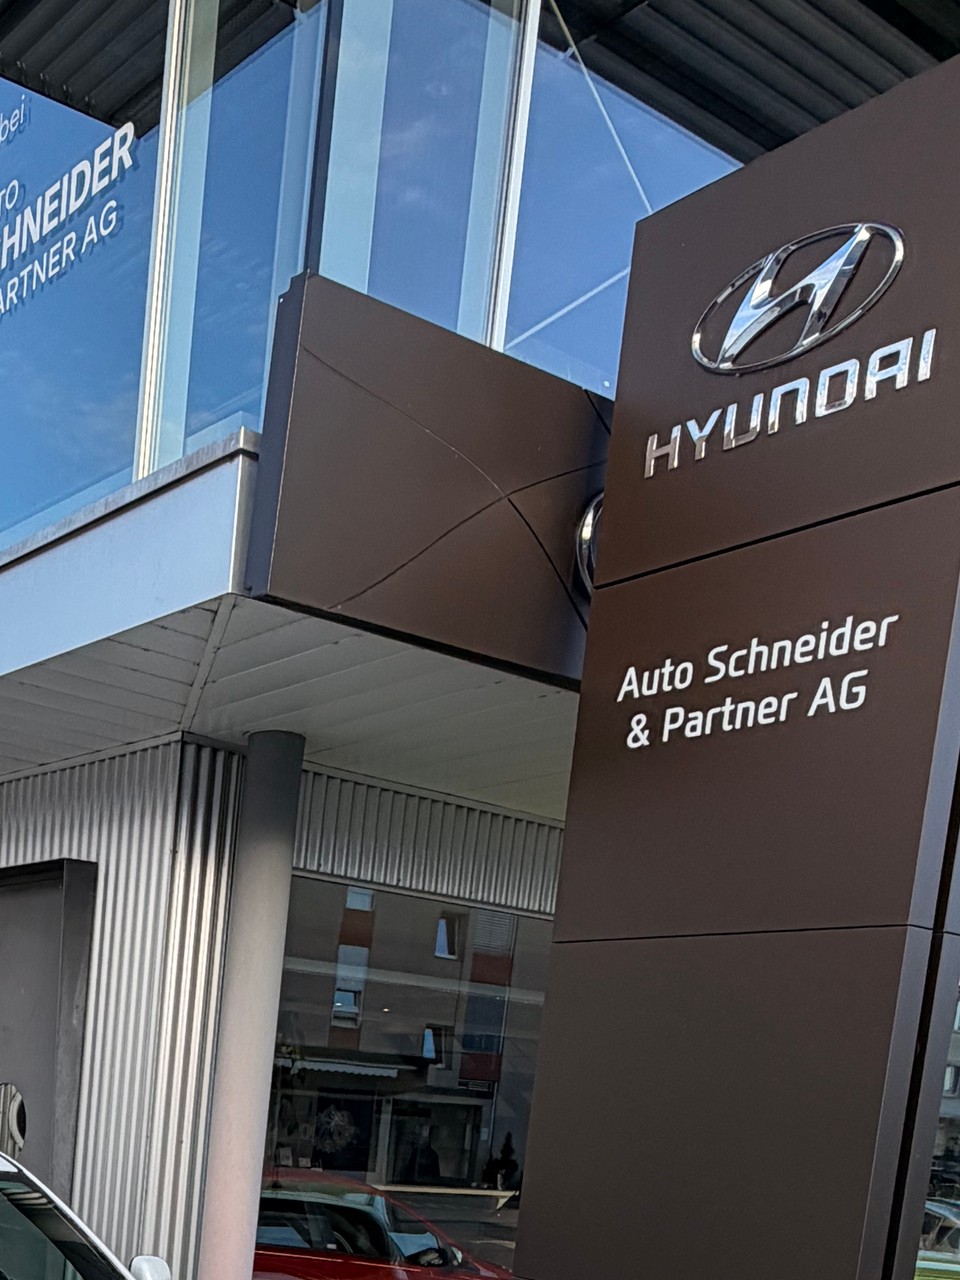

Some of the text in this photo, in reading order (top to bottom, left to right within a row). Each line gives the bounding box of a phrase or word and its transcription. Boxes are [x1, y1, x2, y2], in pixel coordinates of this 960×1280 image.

[81, 199, 118, 253] AG
[643, 328, 937, 478] HYUNDAI
[616, 614, 899, 702] Auto Schneider
[626, 669, 869, 749] & Partner AG
